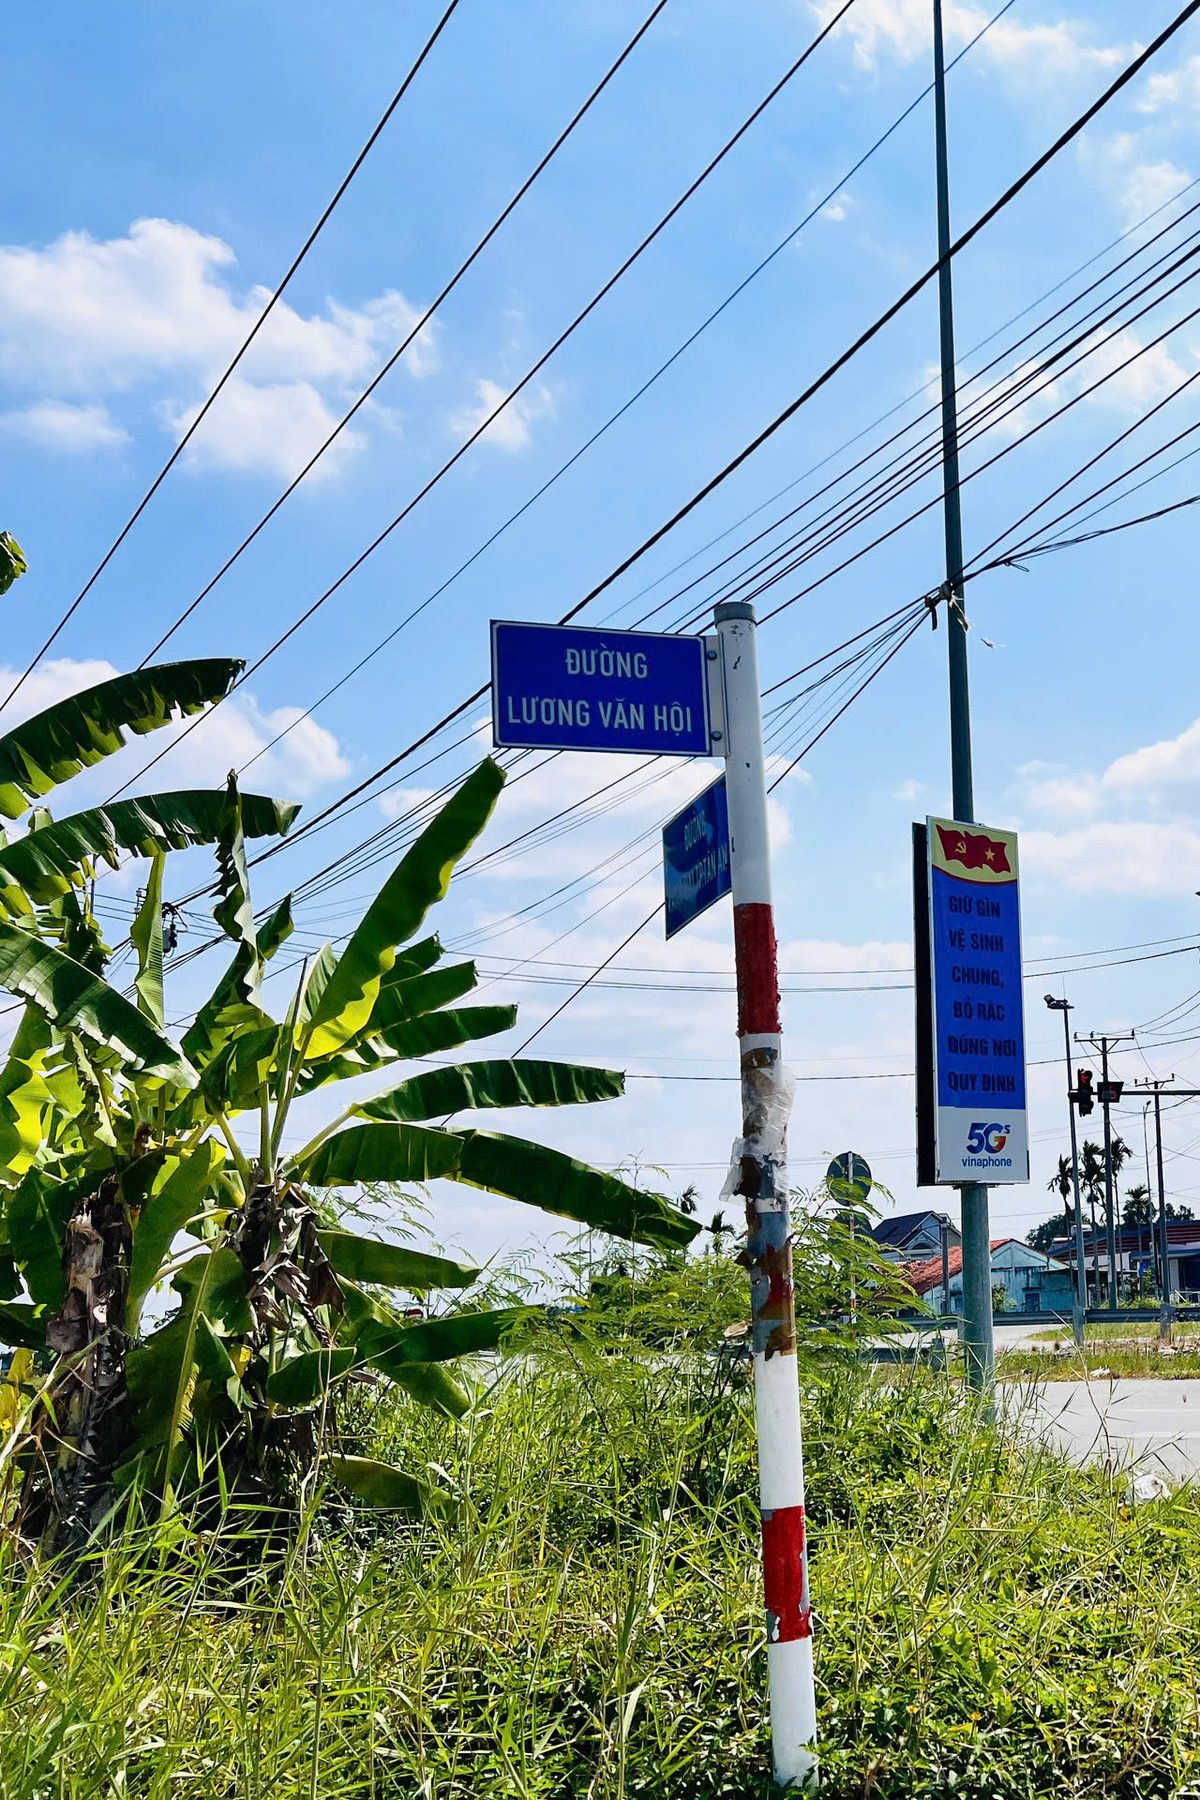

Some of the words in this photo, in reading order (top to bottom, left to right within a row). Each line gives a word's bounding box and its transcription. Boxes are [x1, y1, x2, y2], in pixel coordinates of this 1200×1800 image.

[565, 643, 649, 679] ĐƯỜNG
[507, 695, 591, 727] LƯƠNG
[598, 698, 645, 731] VĂN
[653, 702, 692, 737] HỘI
[948, 895, 974, 915] GIỮ
[976, 897, 1000, 919] GÌN
[948, 928, 966, 952] VỆ
[970, 932, 1004, 953] SINH
[951, 965, 1004, 989] CHUNG,
[953, 996, 974, 1020] BỎ
[976, 1000, 1006, 1022] RÁC
[947, 1033, 989, 1057] ĐÚNG
[991, 1038, 1017, 1058] NƠI
[947, 1071, 977, 1093] QUY
[980, 1072, 1016, 1096] ĐỊNH
[961, 1156, 1012, 1169] vinaphone
